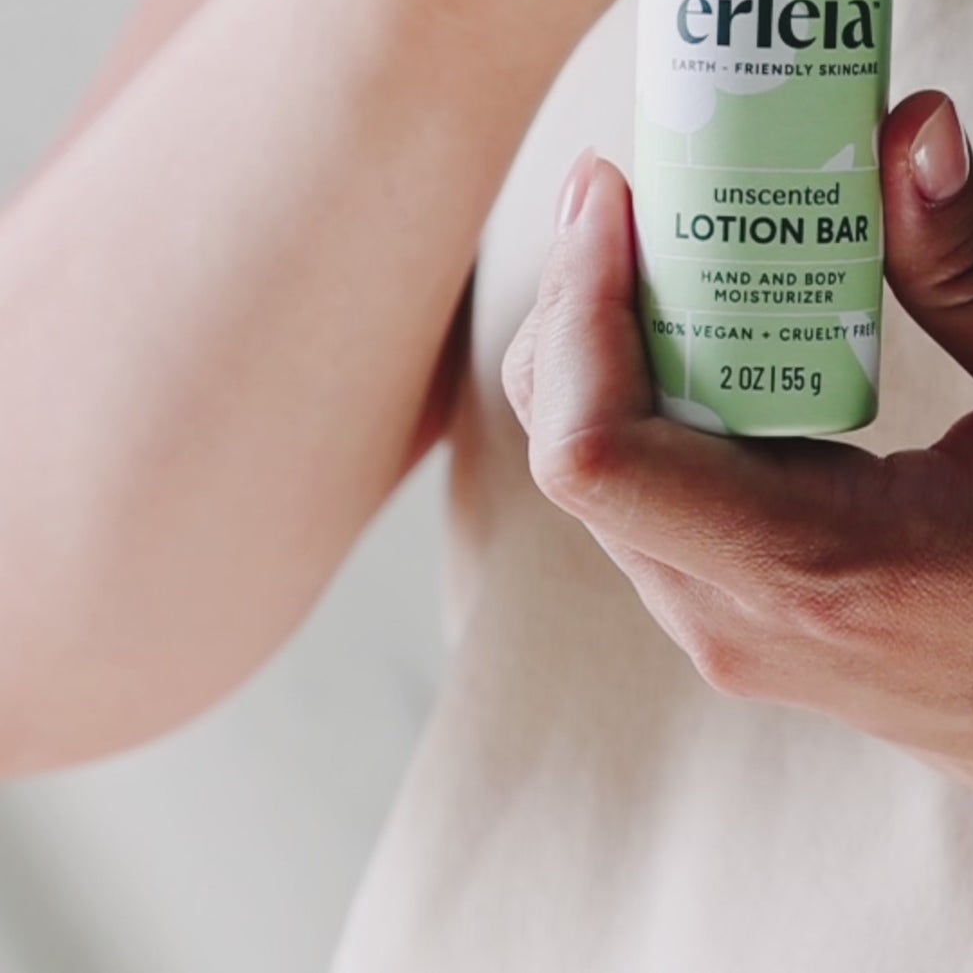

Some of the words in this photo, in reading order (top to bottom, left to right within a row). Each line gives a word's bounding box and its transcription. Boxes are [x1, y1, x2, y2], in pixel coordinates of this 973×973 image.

[672, 58, 716, 73] EARTH
[735, 62, 813, 76] FRIENDLY
[819, 60, 879, 76] SKINCARE
[714, 182, 840, 206] unscented
[675, 213, 804, 244] LOTION
[816, 215, 868, 244] BAR
[701, 270, 751, 286] HAND
[759, 273, 797, 286] AND
[805, 271, 846, 286] BODY
[714, 289, 833, 304] MOISTURIZER
[652, 320, 685, 336] 100%
[692, 324, 753, 340] VEGAN
[762, 330, 770, 339] +
[779, 326, 848, 341] CRUELTY
[720, 365, 732, 390] 2
[811, 372, 822, 396] g
